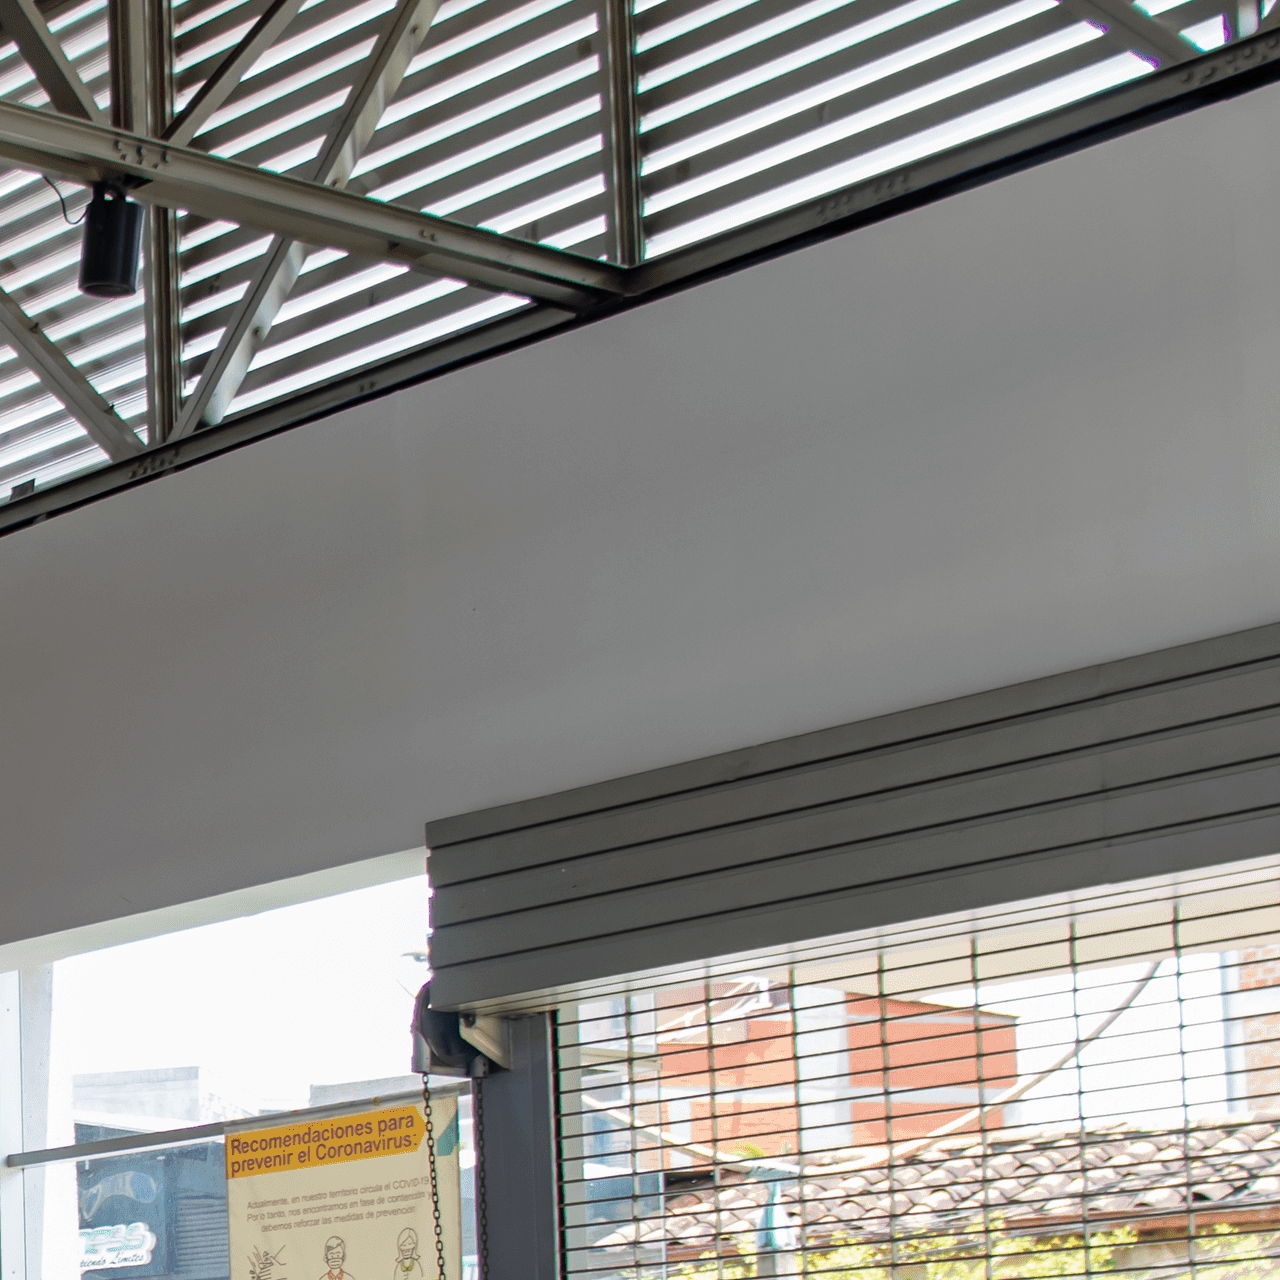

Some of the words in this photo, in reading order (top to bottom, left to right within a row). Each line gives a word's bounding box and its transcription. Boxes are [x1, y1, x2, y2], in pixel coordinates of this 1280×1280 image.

[230, 1120, 373, 1155] Recomendaciones
[377, 1114, 414, 1136] para
[230, 1150, 294, 1178] prevenir
[297, 1146, 311, 1163] el
[315, 1134, 418, 1160] Coronavirus:
[360, 1184, 382, 1194] circula
[384, 1182, 390, 1190] el
[376, 1196, 385, 1204] de
[322, 1216, 332, 1225] las
[333, 1212, 364, 1223] medidas
[365, 1210, 374, 1219] de
